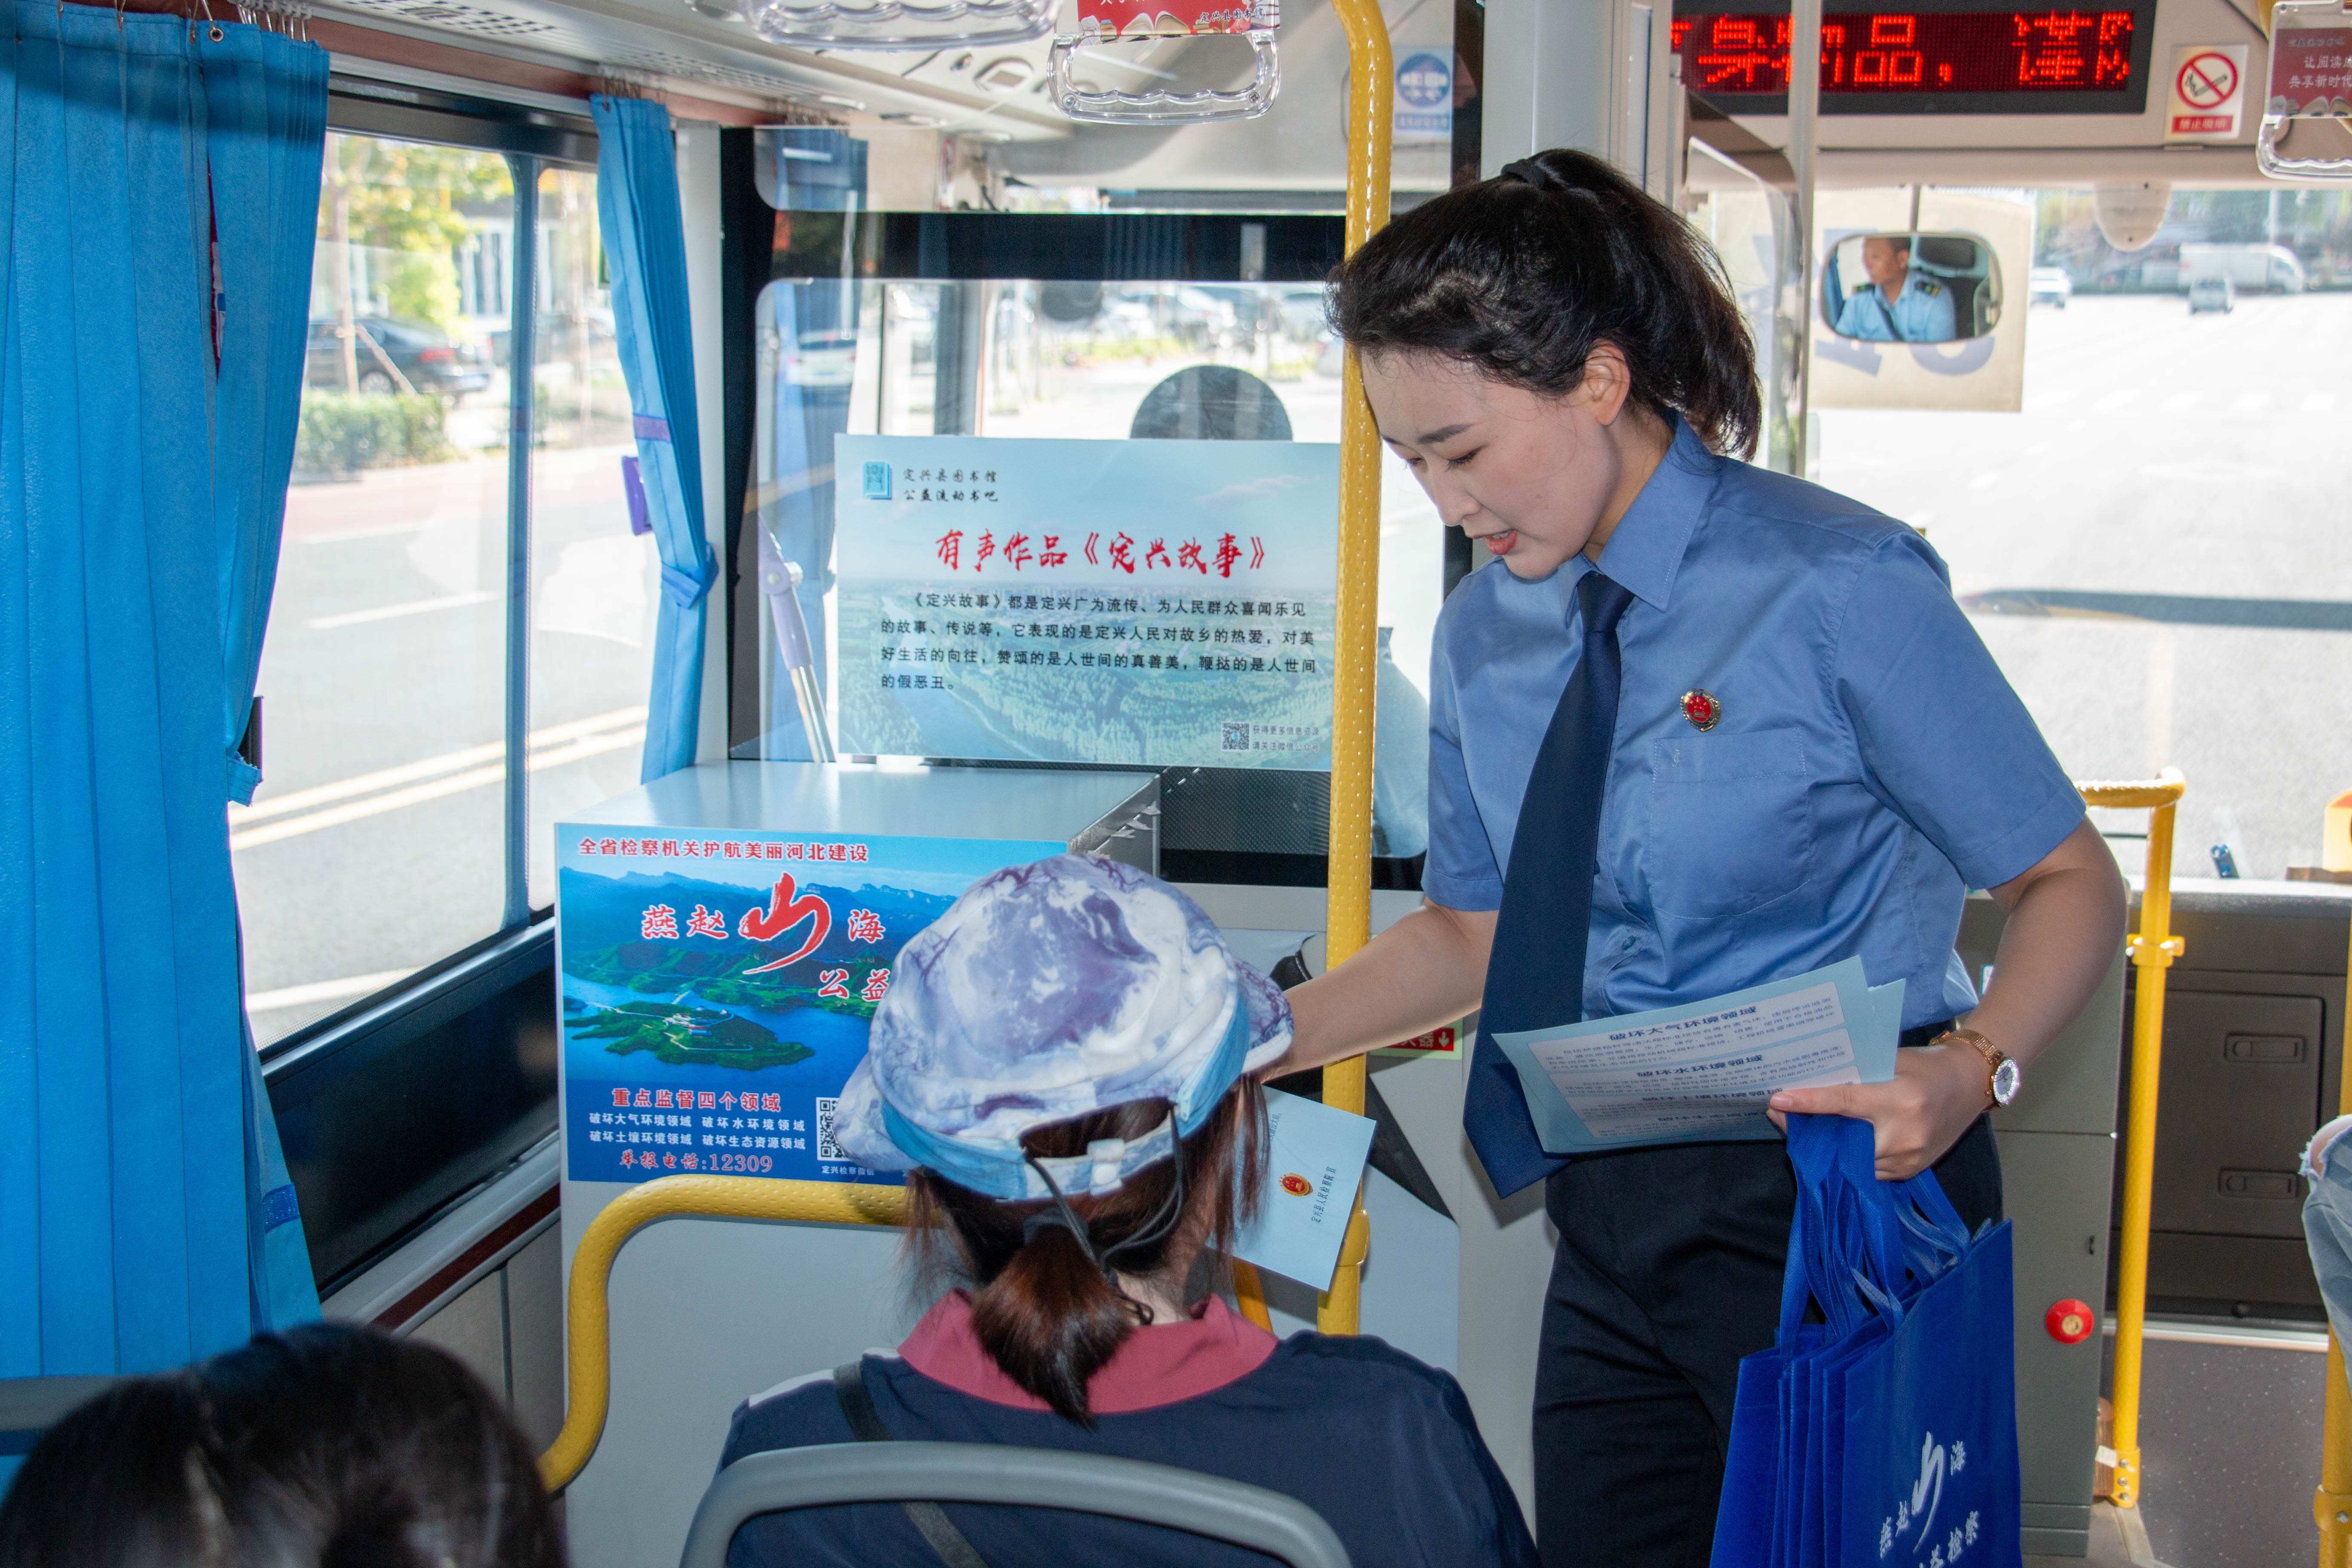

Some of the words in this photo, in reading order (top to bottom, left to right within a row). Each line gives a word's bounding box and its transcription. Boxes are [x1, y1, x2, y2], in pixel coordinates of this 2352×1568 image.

[903, 468, 997, 483] 定兴县图书馆
[903, 488, 998, 502] 公益流动书吧
[936, 528, 1266, 578] 有声作品《定兴故事》
[914, 592, 1306, 616] 《定兴故事》都是定兴广为流传、为人民群众喜闻乐见
[881, 674, 954, 689] 的假恶丑。
[1253, 725, 1319, 736] 获得更多信息资源
[1253, 741, 1319, 752] 请关注微信公众号
[578, 837, 869, 863] 全省检察机关护航美丽河北建设
[1609, 1006, 1756, 1040] 破坏大气环境领域
[1637, 1054, 1762, 1077] 破坏水环境领域
[612, 1088, 781, 1112] 重点监督四个领域
[589, 1112, 692, 1127] 破坏大气环境领域
[701, 1116, 805, 1132] 破坏水环境领域
[589, 1130, 692, 1145] 破坏土壤环境领域
[702, 1135, 806, 1149] 破坏生态资源领域
